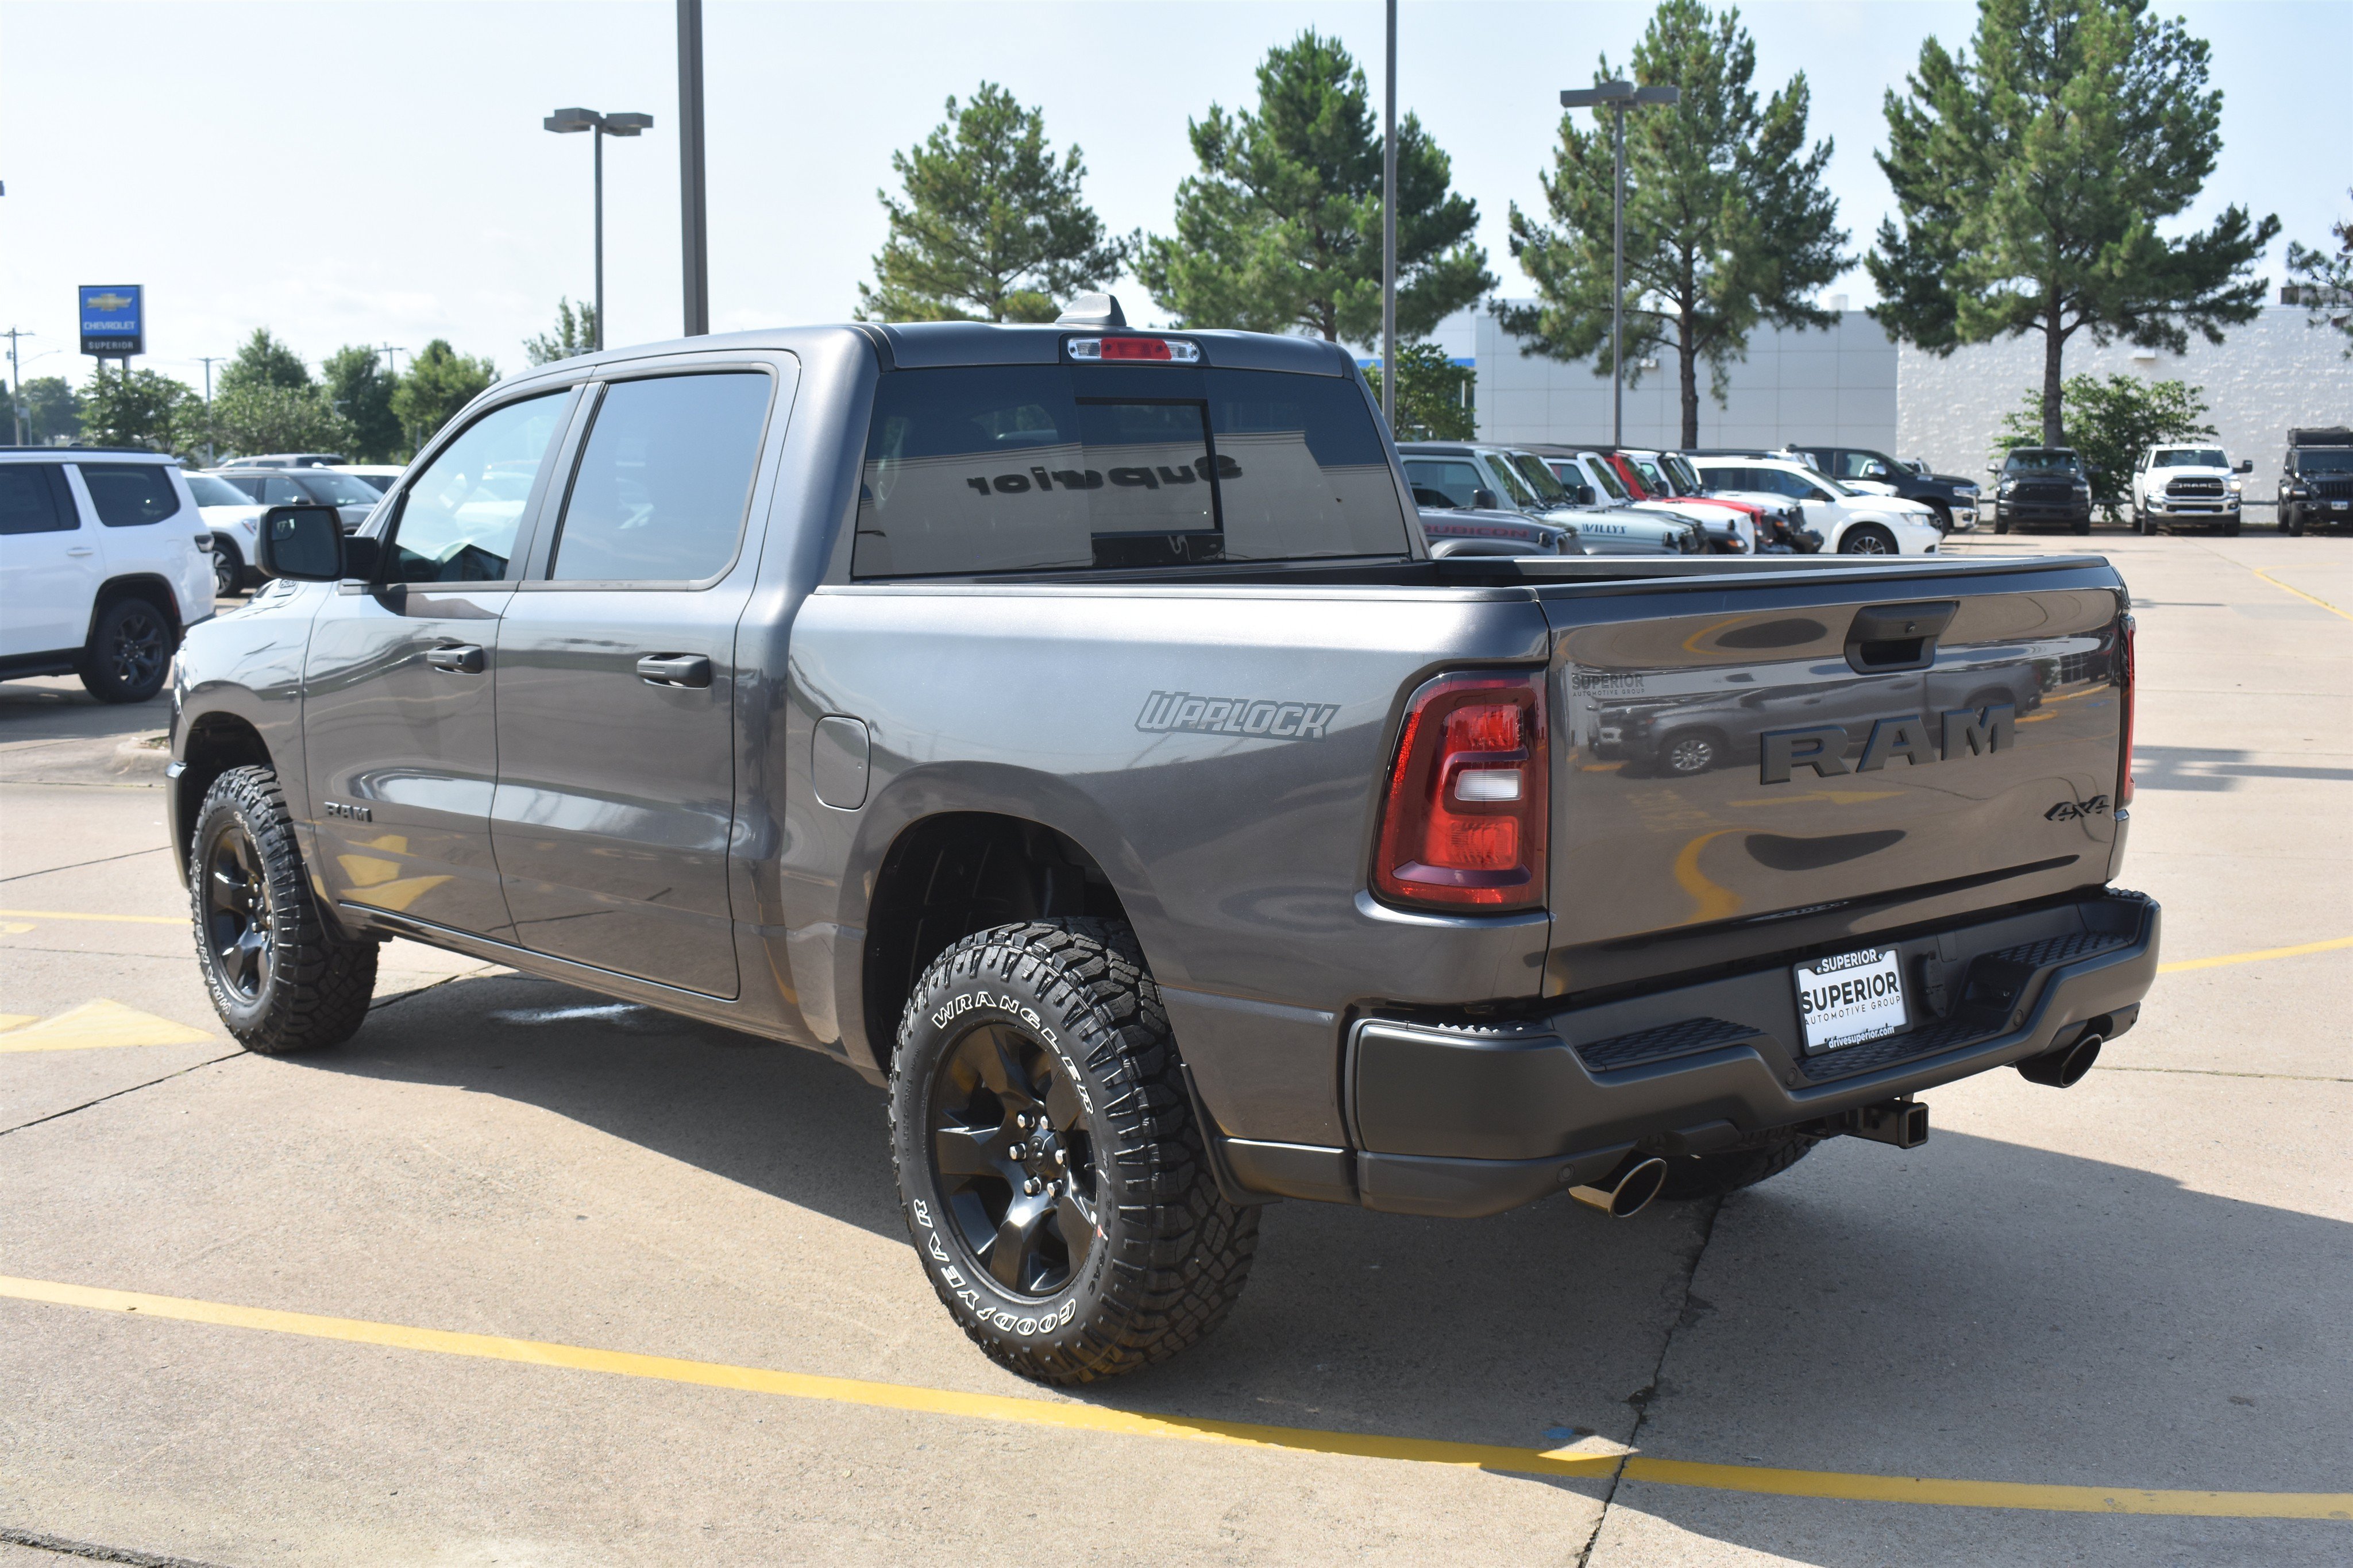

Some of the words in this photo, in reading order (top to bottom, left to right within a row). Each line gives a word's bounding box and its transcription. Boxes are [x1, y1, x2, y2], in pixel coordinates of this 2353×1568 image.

[84, 321, 136, 330] CHEVROLET
[88, 341, 133, 350] SUPERIOR
[1582, 523, 1626, 534] WILLYS
[1572, 674, 1644, 690] SUPERIOR
[1134, 690, 1341, 743] WARLOCK
[1760, 703, 2015, 785] RAM
[324, 801, 372, 822] RAM
[1822, 949, 1877, 972] SUPERIOR
[1801, 971, 1900, 1014] SUPERIOR
[1804, 1004, 1866, 1026] AUTOMOTIVE
[1871, 995, 1900, 1010] GROUP
[1828, 1025, 1895, 1049] drivesuperior.com
[932, 991, 1095, 1115] WRANGLER
[914, 1199, 1077, 1336] GOODYEAR
